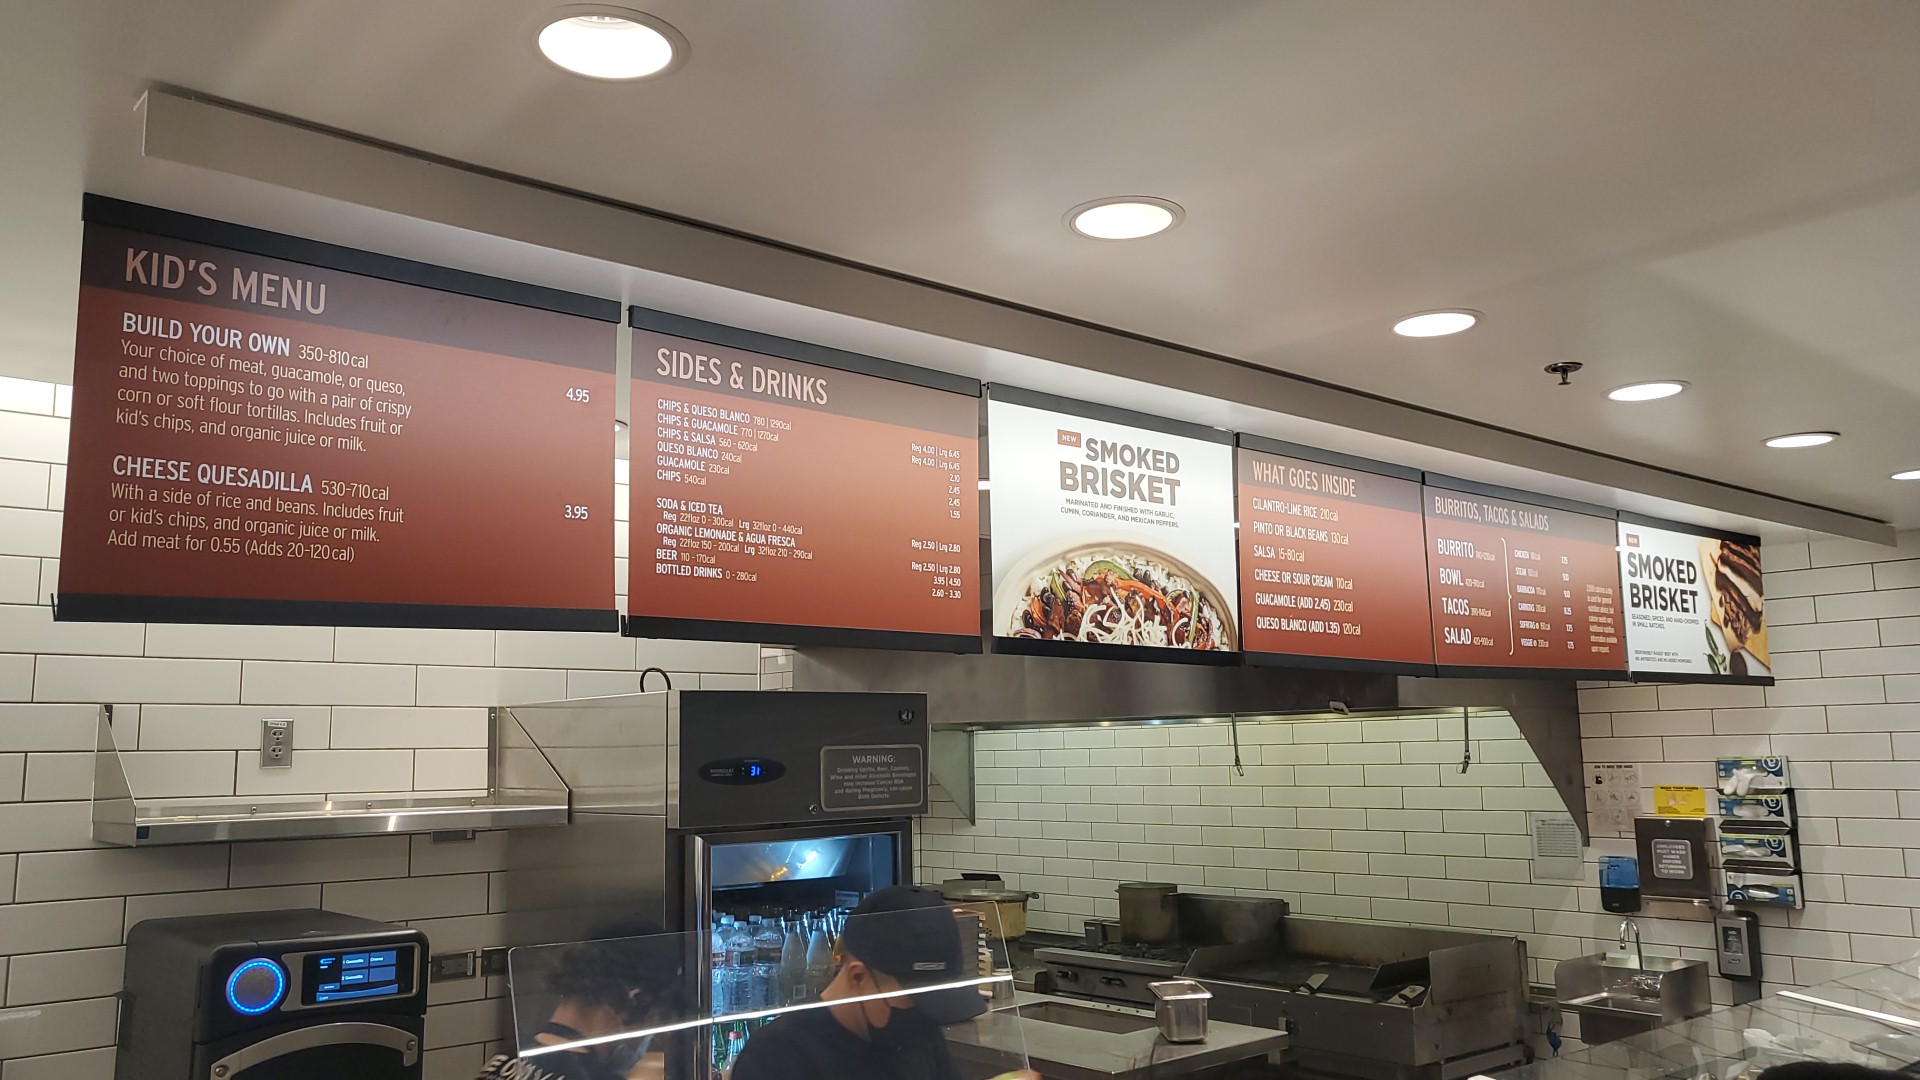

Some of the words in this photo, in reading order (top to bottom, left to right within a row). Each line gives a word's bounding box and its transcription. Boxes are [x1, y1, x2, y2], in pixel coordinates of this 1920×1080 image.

[125, 247, 217, 295] KID'S
[232, 267, 326, 314] MENU
[122, 311, 182, 339] BUILD
[189, 322, 242, 349] YOUR
[248, 332, 290, 356] OWN
[121, 338, 155, 358] Your
[159, 345, 206, 366] choice
[210, 353, 225, 368] of
[228, 358, 267, 377] meat,
[271, 364, 345, 388] guacamole,
[348, 376, 363, 388] or
[366, 378, 405, 396] queso,
[656, 347, 721, 385] SIDES
[729, 361, 744, 389] &
[752, 365, 827, 404] DRINKS
[118, 364, 147, 380] and
[152, 366, 179, 385] two
[183, 370, 244, 396] toppings
[249, 379, 263, 396] to
[267, 385, 284, 401] go
[288, 386, 316, 403] with
[319, 393, 328, 405] a
[331, 393, 356, 409] pair
[359, 396, 373, 410] of
[375, 399, 412, 419] crispy
[565, 387, 589, 403] 4.95
[117, 388, 151, 404] corn
[156, 393, 173, 406] or
[176, 394, 205, 411] soft
[209, 396, 243, 415] flour
[246, 401, 300, 423] tortillas.
[304, 408, 356, 430] Includes
[360, 415, 386, 433] fruit
[389, 423, 403, 435] or
[657, 398, 681, 412] CHIPS
[683, 402, 689, 413] &
[691, 404, 717, 418] QUESO
[719, 408, 750, 423] BLANCO
[116, 407, 149, 427] kid's
[153, 412, 194, 434] chips,
[199, 420, 226, 435] and
[230, 425, 281, 442] organic
[283, 427, 315, 446] juice
[319, 435, 334, 447] or
[337, 435, 366, 452] milk.
[657, 412, 681, 426] CHIPS
[683, 416, 689, 427] &
[691, 417, 738, 435] GUACAMOLE
[657, 426, 681, 440] CHIPS
[683, 430, 689, 441] &
[690, 431, 716, 445] SALSA
[1061, 433, 1077, 442] NEW
[656, 440, 684, 454] QUESO
[686, 444, 718, 459] BLANCO
[721, 451, 742, 462] 240cal
[1085, 437, 1180, 474] SMOKED
[112, 454, 191, 482] CHEESE
[197, 463, 313, 493] QUESADILLA
[656, 454, 706, 471] GUACAMOLE
[708, 463, 729, 475] 230cal
[656, 468, 681, 482] CHIPS
[684, 473, 706, 485] 540cal
[1059, 460, 1180, 506] BRISKET
[1252, 460, 1285, 485] WHAT
[1288, 467, 1318, 490] GOES
[1321, 472, 1356, 497] INSIDE
[948, 485, 960, 495] 2.45
[111, 482, 143, 500] With
[148, 489, 158, 501] a
[162, 487, 192, 505] side
[196, 490, 212, 506] of
[215, 492, 241, 509] rice
[245, 496, 271, 511] and
[276, 496, 318, 515] beans.
[322, 501, 374, 520] Includes
[378, 506, 404, 523] fruit
[564, 504, 588, 520] 3.95
[656, 497, 678, 510] SODA
[680, 500, 686, 511] &
[688, 500, 706, 513] ICED
[707, 503, 723, 515] TEA
[1065, 497, 1099, 508] MARINATED
[1099, 502, 1112, 510] AND
[1113, 504, 1138, 514] FINISHED
[1139, 508, 1153, 516] WITH
[1252, 497, 1302, 516] CILANTRO-LIME
[1302, 505, 1317, 518] RICE
[1434, 495, 1481, 522] BURRITOS,
[1482, 504, 1509, 524] TACOS
[1511, 509, 1517, 525] &
[1518, 510, 1548, 531] SALADS
[949, 509, 960, 519] 1.55
[1060, 506, 1081, 516] CUMIN,
[1081, 509, 1116, 520] CORIANDER,
[1130, 515, 1155, 525] MEXICAN
[1155, 519, 1179, 528] PEPPERS.
[656, 522, 692, 536] ORGANIC
[694, 526, 737, 541] LEMONADE
[737, 531, 744, 542] &
[745, 532, 766, 544] AGUA
[767, 534, 795, 547] FRESCA
[1253, 520, 1273, 535] PINTO
[1274, 523, 1284, 536] OR
[1285, 525, 1306, 539] BLACK
[1307, 528, 1328, 542] BEANS
[107, 529, 137, 546] Add
[142, 533, 181, 549] meat
[185, 534, 206, 551] for
[210, 536, 240, 553] 0.55
[244, 539, 283, 556] (Adds
[1253, 544, 1275, 559] SALSA
[1437, 537, 1474, 558] BURRITO
[656, 548, 677, 560] BEER
[655, 562, 691, 576] BOTTLED
[693, 565, 722, 578] DRINKS
[1254, 568, 1280, 583] CHEESE
[1281, 571, 1291, 584] OR
[1292, 572, 1310, 585] SOUR
[1311, 574, 1333, 588] CREAM
[1439, 567, 1464, 586] BOWL
[1627, 551, 1697, 585] SMOKED
[948, 577, 961, 586] 4.50
[1255, 592, 1296, 607] GUACAMOLE
[1296, 596, 1313, 609] (ADD
[1314, 597, 1331, 611] 2.45)
[1441, 596, 1469, 615] TACOS
[1629, 582, 1698, 614] BRISKET
[1256, 615, 1279, 630] QUESO
[1280, 617, 1307, 631] BLANCO
[1308, 620, 1324, 633] (ADD
[1324, 621, 1340, 635] 1.35)
[1444, 626, 1471, 644] SALAD
[852, 754, 896, 764] WARNING:
